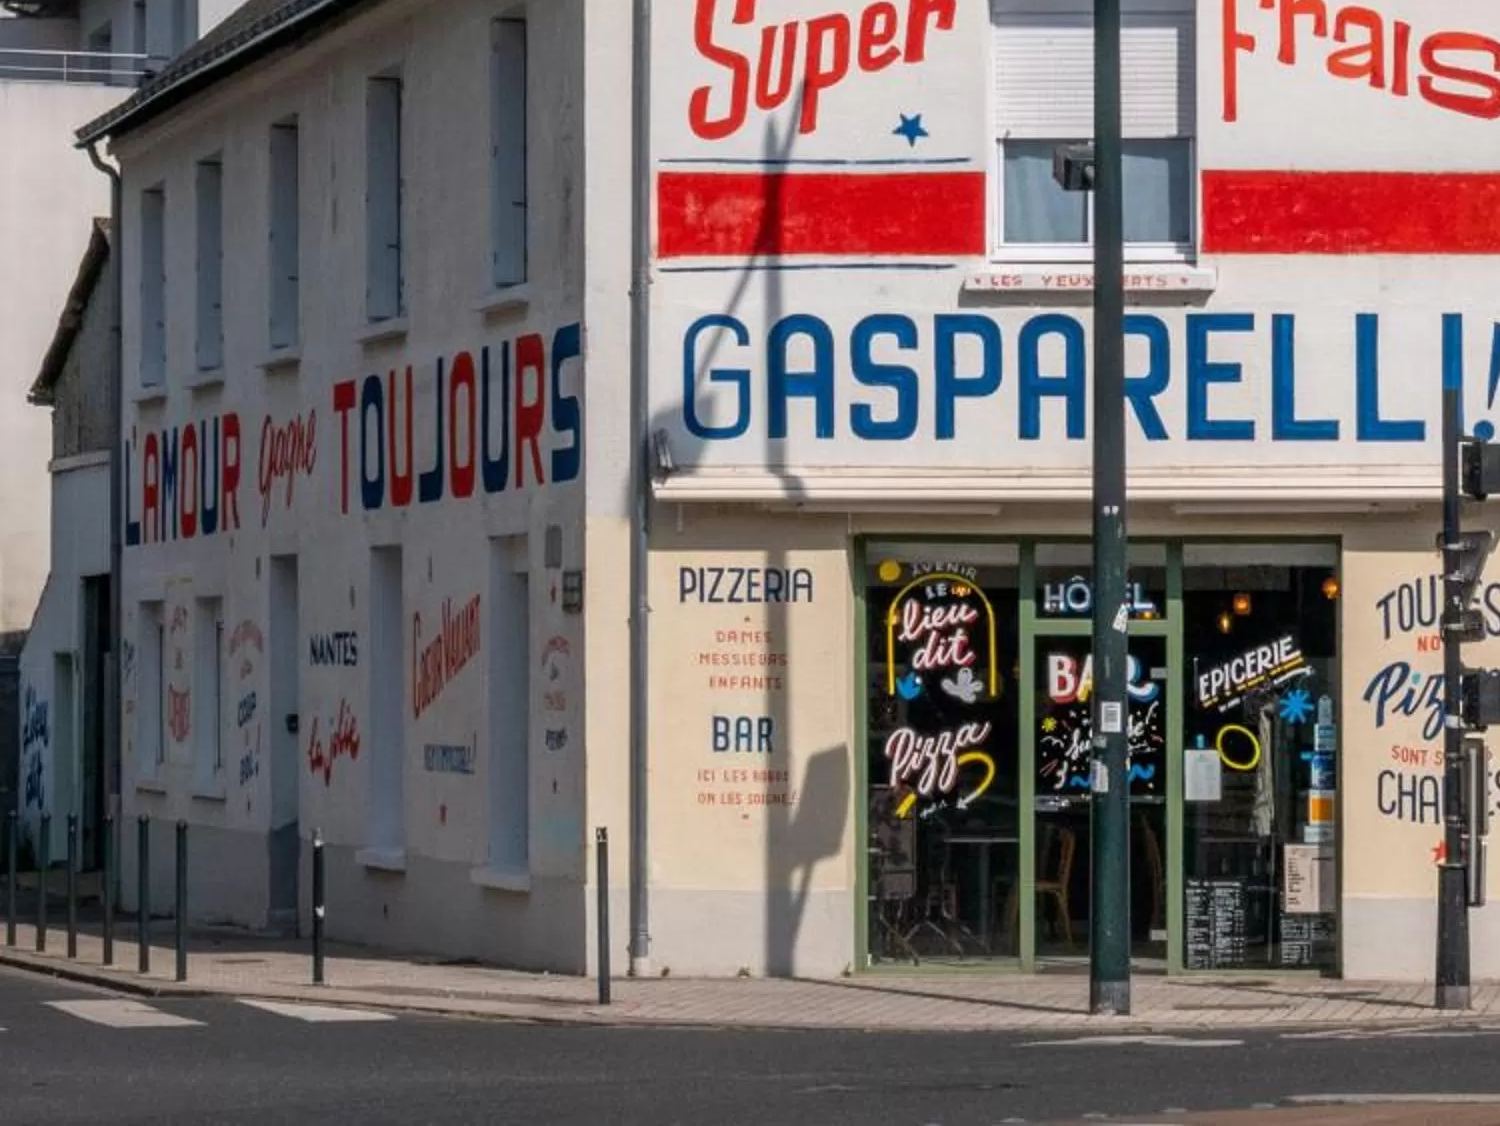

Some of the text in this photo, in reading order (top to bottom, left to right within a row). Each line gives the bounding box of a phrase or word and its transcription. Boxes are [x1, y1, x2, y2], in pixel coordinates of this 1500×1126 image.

[124, 411, 241, 546] L'AMOUR
[333, 322, 582, 515] TOUJOURS
[679, 567, 813, 603] PIZZERIA
[925, 583, 947, 599] LE
[1044, 575, 1154, 612] HÔL
[715, 630, 773, 644] DAMES
[898, 598, 978, 640] lieu
[310, 631, 357, 666] NANTES
[699, 653, 788, 667] MESSIEURS
[913, 628, 976, 670] dit
[709, 676, 782, 690] ENFANTS
[1200, 635, 1302, 702] EPICERIE
[712, 715, 774, 753] BAR
[885, 722, 991, 794] Pizza
[1391, 745, 1428, 764] SONT
